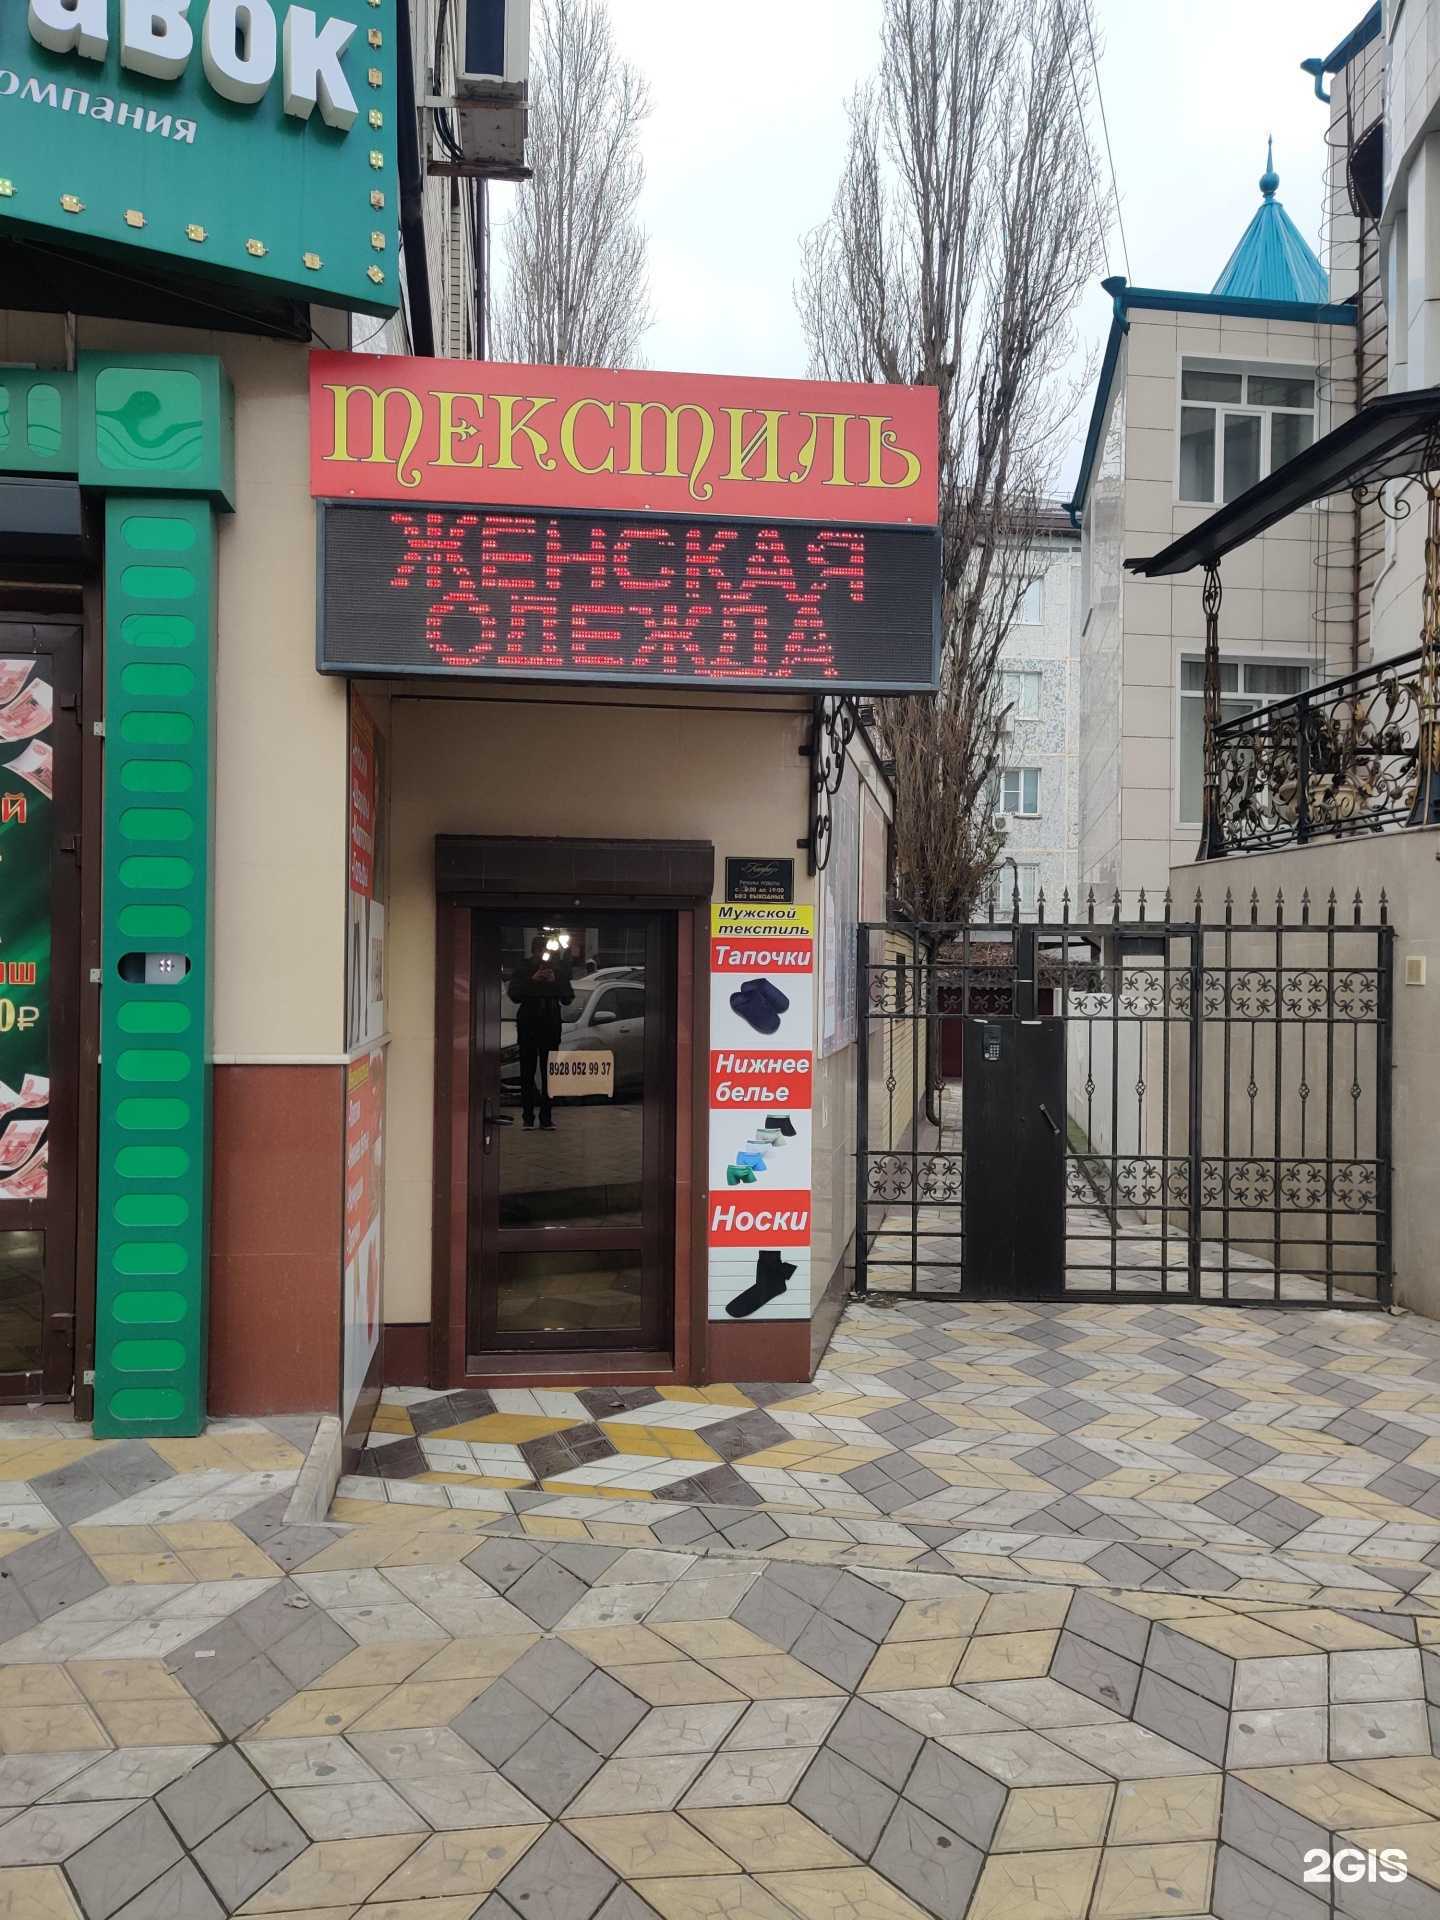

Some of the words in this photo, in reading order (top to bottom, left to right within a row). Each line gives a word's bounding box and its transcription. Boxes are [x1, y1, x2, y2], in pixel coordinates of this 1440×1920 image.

[322, 383, 922, 502] ТЕКСТИЛЬ
[389, 513, 866, 602] ЖЕНСКАЯ
[425, 592, 840, 679] ОДЕЖДА
[718, 906, 796, 921] Мужской
[718, 925, 810, 936] текстиль
[716, 945, 812, 967] Тапочки
[549, 1062, 569, 1075] 8928
[572, 1062, 586, 1075] 052
[589, 1062, 598, 1075] 99
[601, 1062, 611, 1075] 37
[715, 1054, 809, 1074] Нижнее
[715, 1081, 790, 1102] белье
[711, 1205, 808, 1232] Носки
